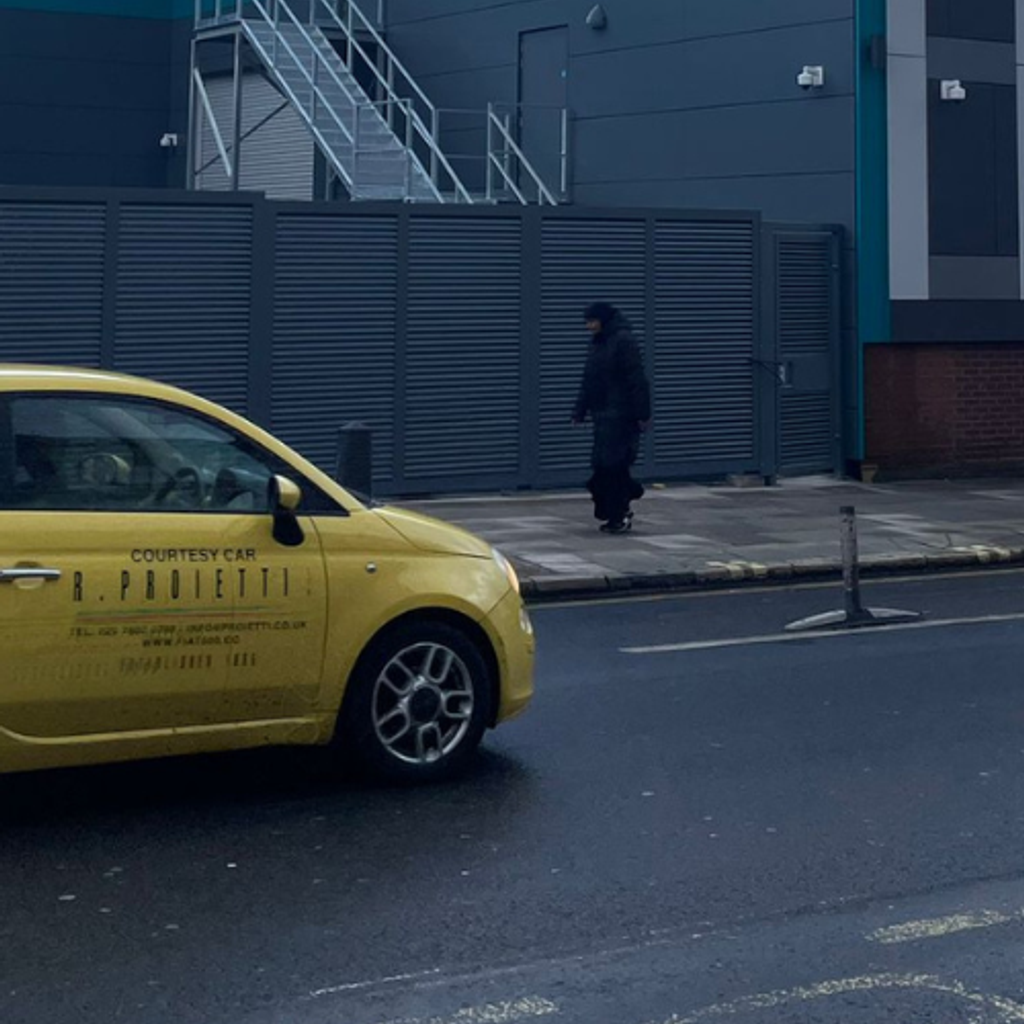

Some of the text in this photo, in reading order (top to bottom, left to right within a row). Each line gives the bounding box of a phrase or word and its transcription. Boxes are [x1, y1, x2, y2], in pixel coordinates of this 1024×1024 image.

[131, 548, 257, 562] COURTESY CAR
[121, 567, 289, 601] PROIETTI
